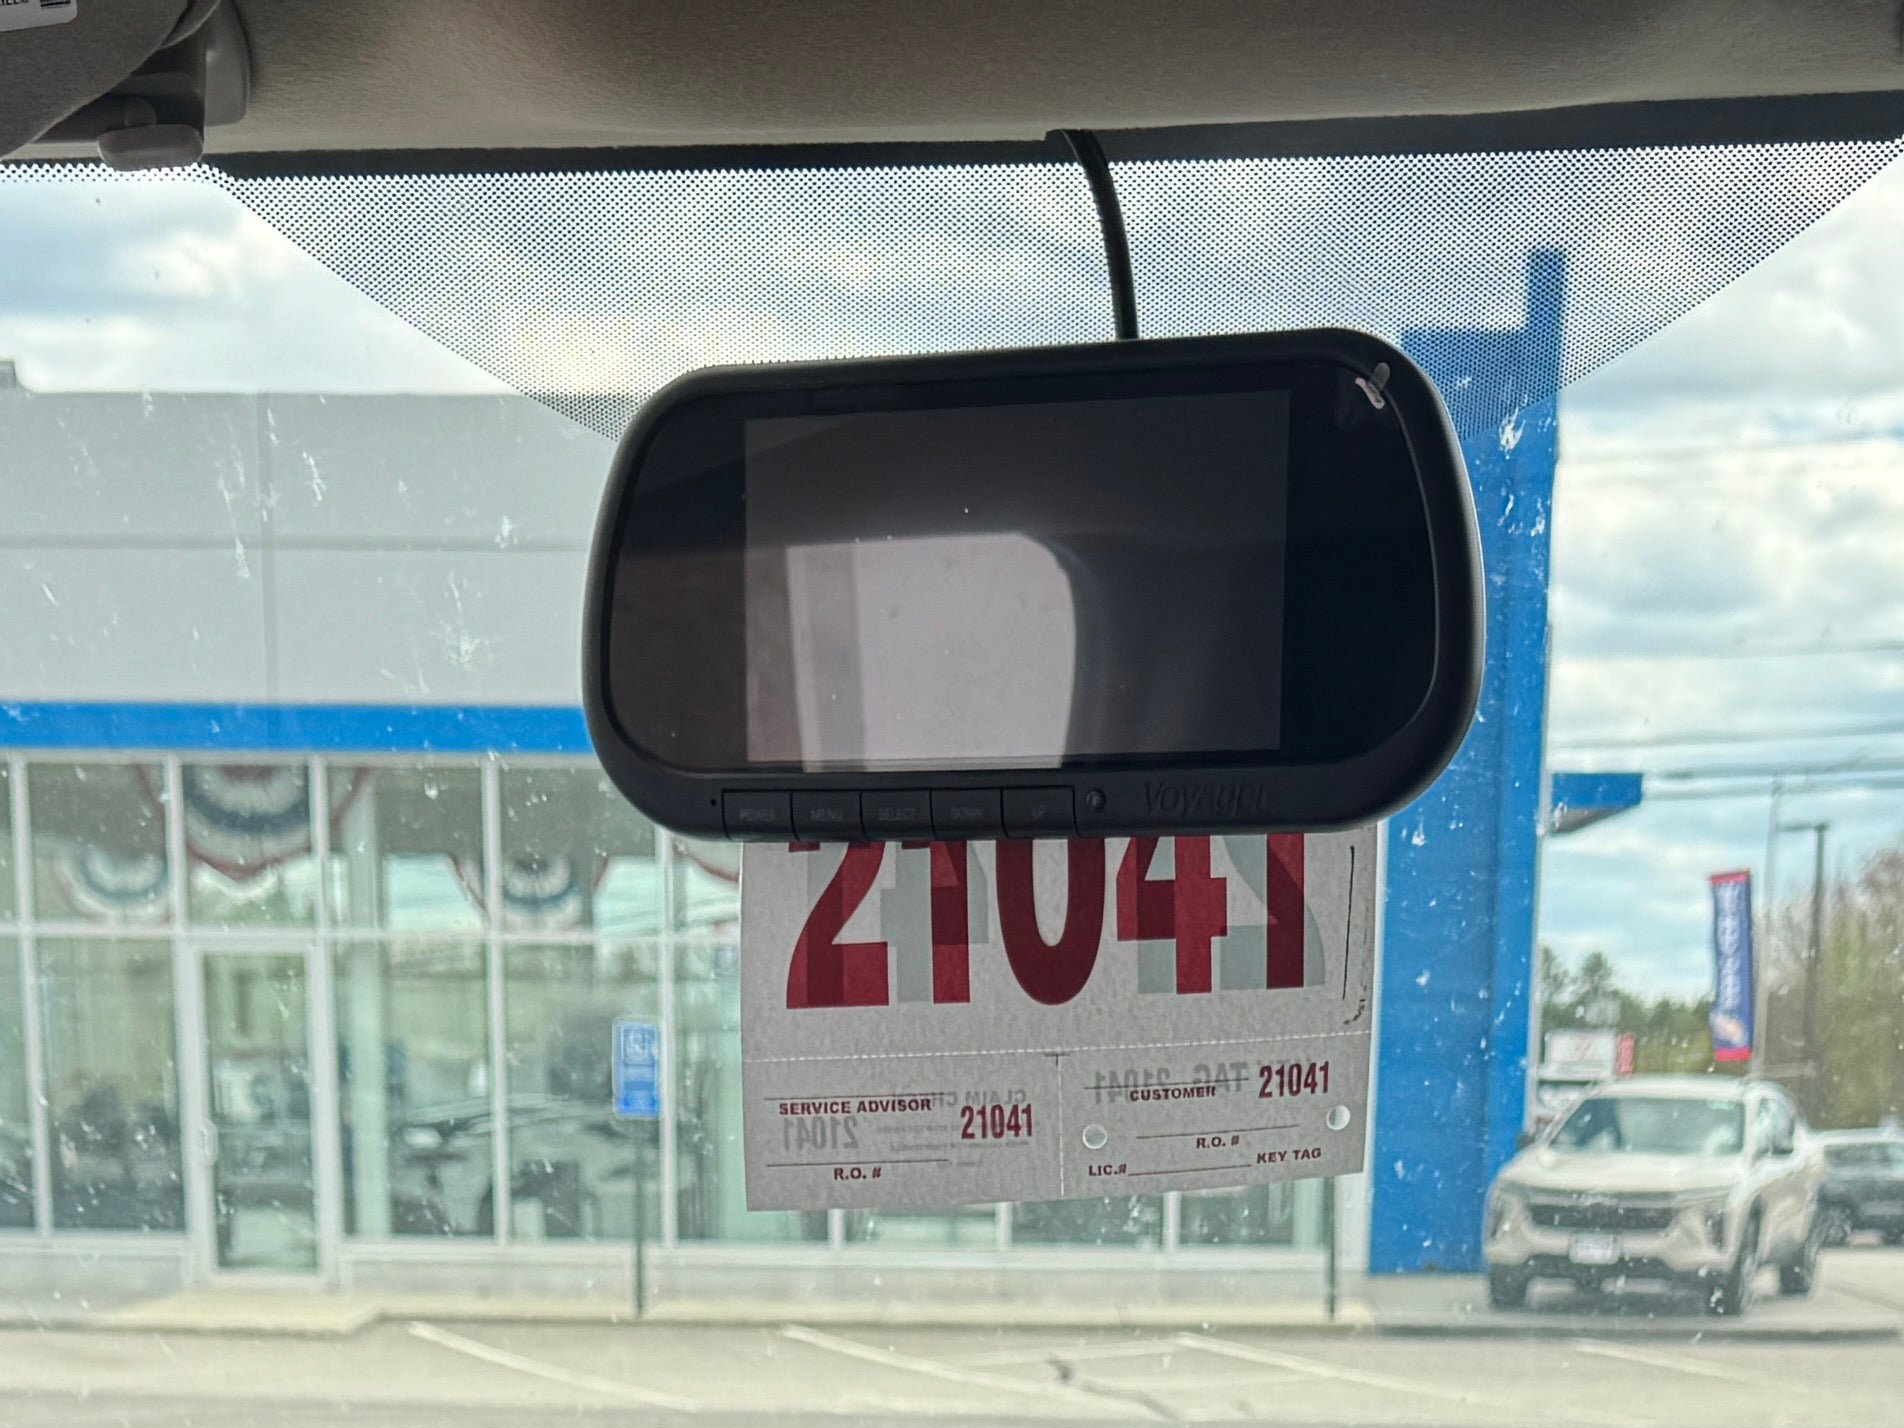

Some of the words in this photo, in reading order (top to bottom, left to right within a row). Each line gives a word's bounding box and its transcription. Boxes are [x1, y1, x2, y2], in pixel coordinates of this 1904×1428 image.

[787, 835, 1305, 1009] 21041
[1258, 1061, 1329, 1098] 21041
[1129, 1086, 1216, 1101] CUSTOMER
[779, 1100, 852, 1115] SERVICE
[856, 1097, 932, 1113] ADVISOR
[960, 1103, 1034, 1140] 21041
[1196, 1137, 1226, 1149] R.O.
[1256, 1151, 1287, 1164] KEY
[1292, 1147, 1322, 1161] TAG
[834, 1167, 867, 1180] R.O.
